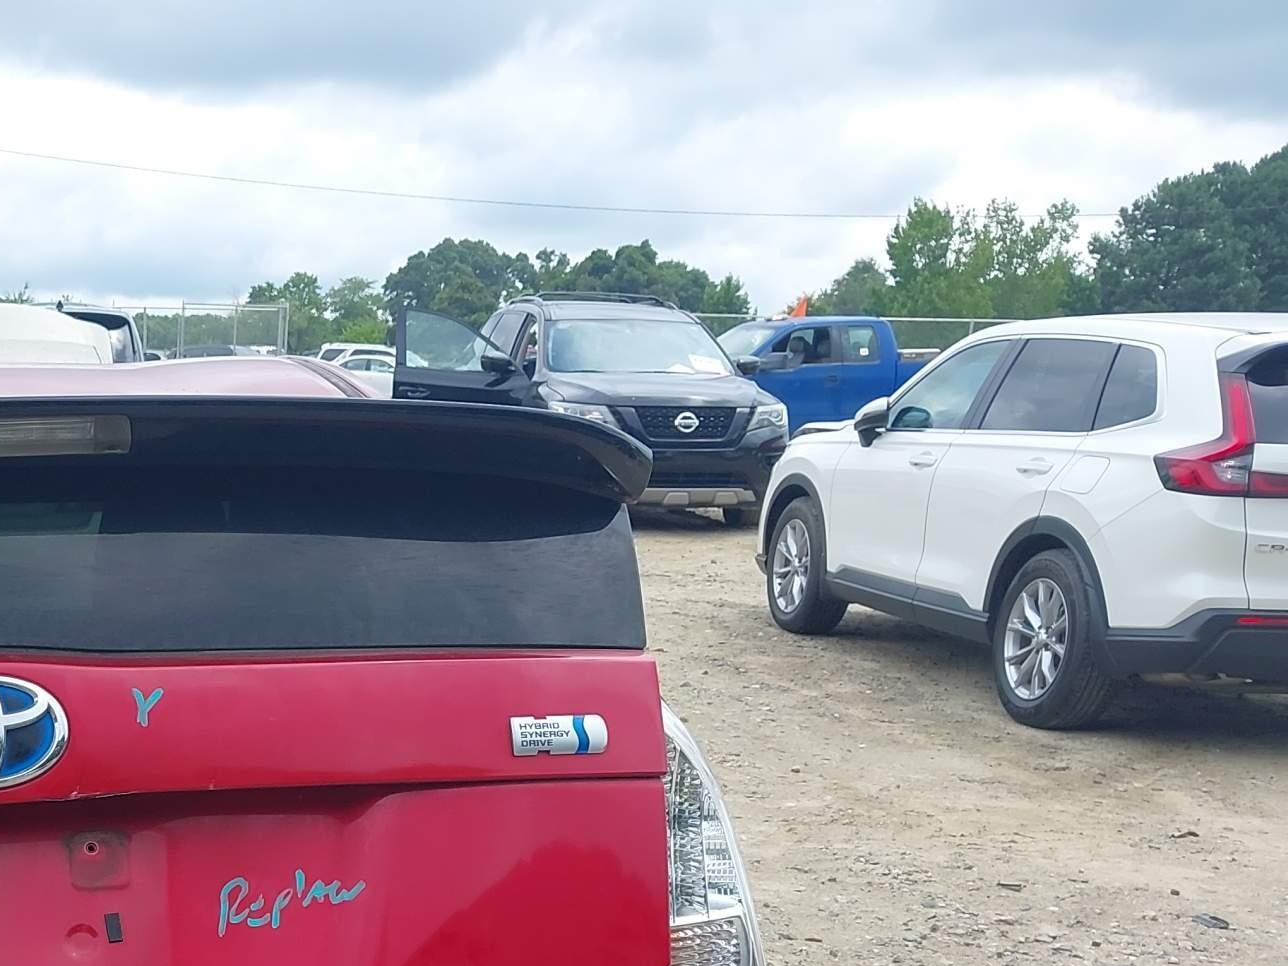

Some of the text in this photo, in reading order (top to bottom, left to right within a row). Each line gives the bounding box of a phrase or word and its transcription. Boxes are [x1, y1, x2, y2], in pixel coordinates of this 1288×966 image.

[519, 722, 560, 731] HYBRID
[520, 730, 570, 739] SYNERGY
[521, 739, 554, 748] DRIVE
